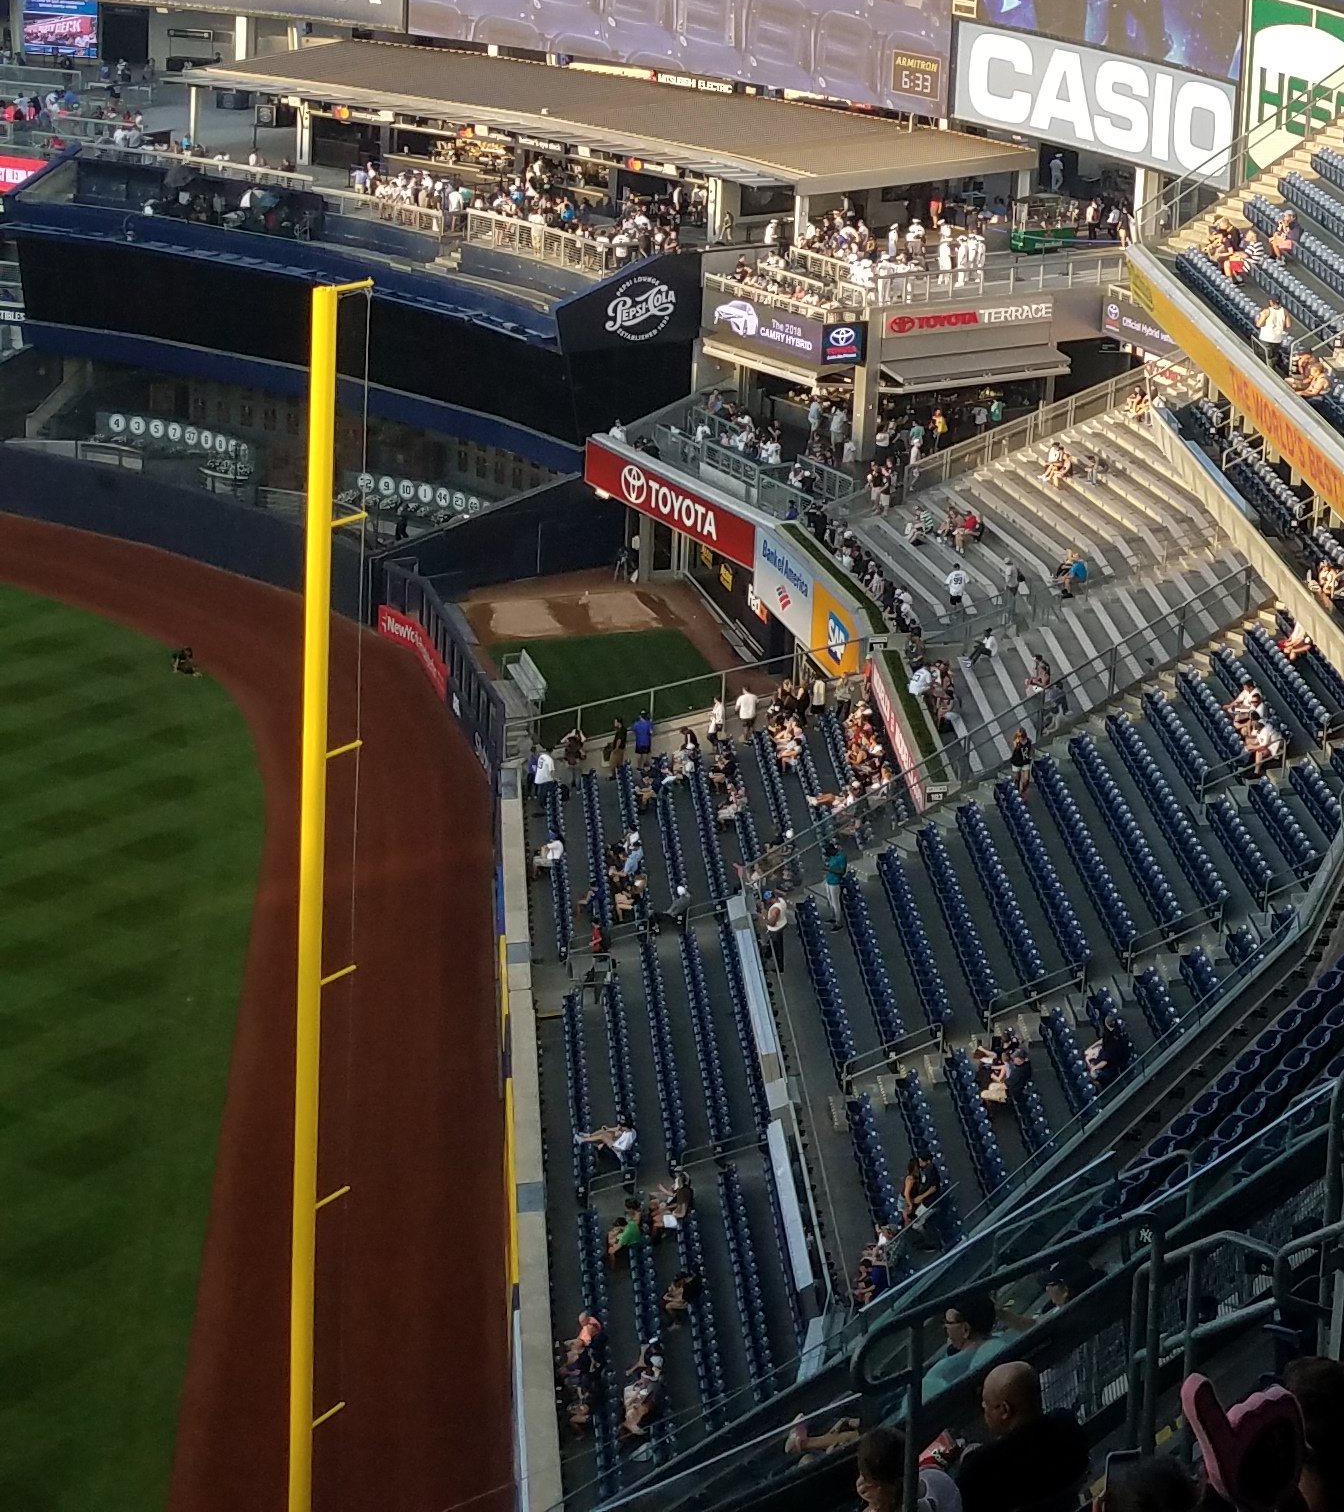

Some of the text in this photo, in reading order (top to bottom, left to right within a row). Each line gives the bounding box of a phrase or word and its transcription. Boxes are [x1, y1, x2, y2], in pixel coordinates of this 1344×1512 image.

[895, 55, 939, 73] ARMITRON
[697, 79, 734, 94] ELECTRIC
[901, 70, 932, 94] 6:33
[968, 33, 1232, 176] CASIO
[634, 276, 660, 286] LOUNGE
[771, 318, 802, 337] The 2018
[916, 303, 1053, 329] TOYOTA TERRACE
[759, 326, 813, 351] CAMRY HYBRID
[1251, 391, 1306, 469] WORLD'S
[648, 479, 718, 542] TOYOTA
[762, 539, 809, 598] Bank of America
[827, 617, 846, 660] SAP
